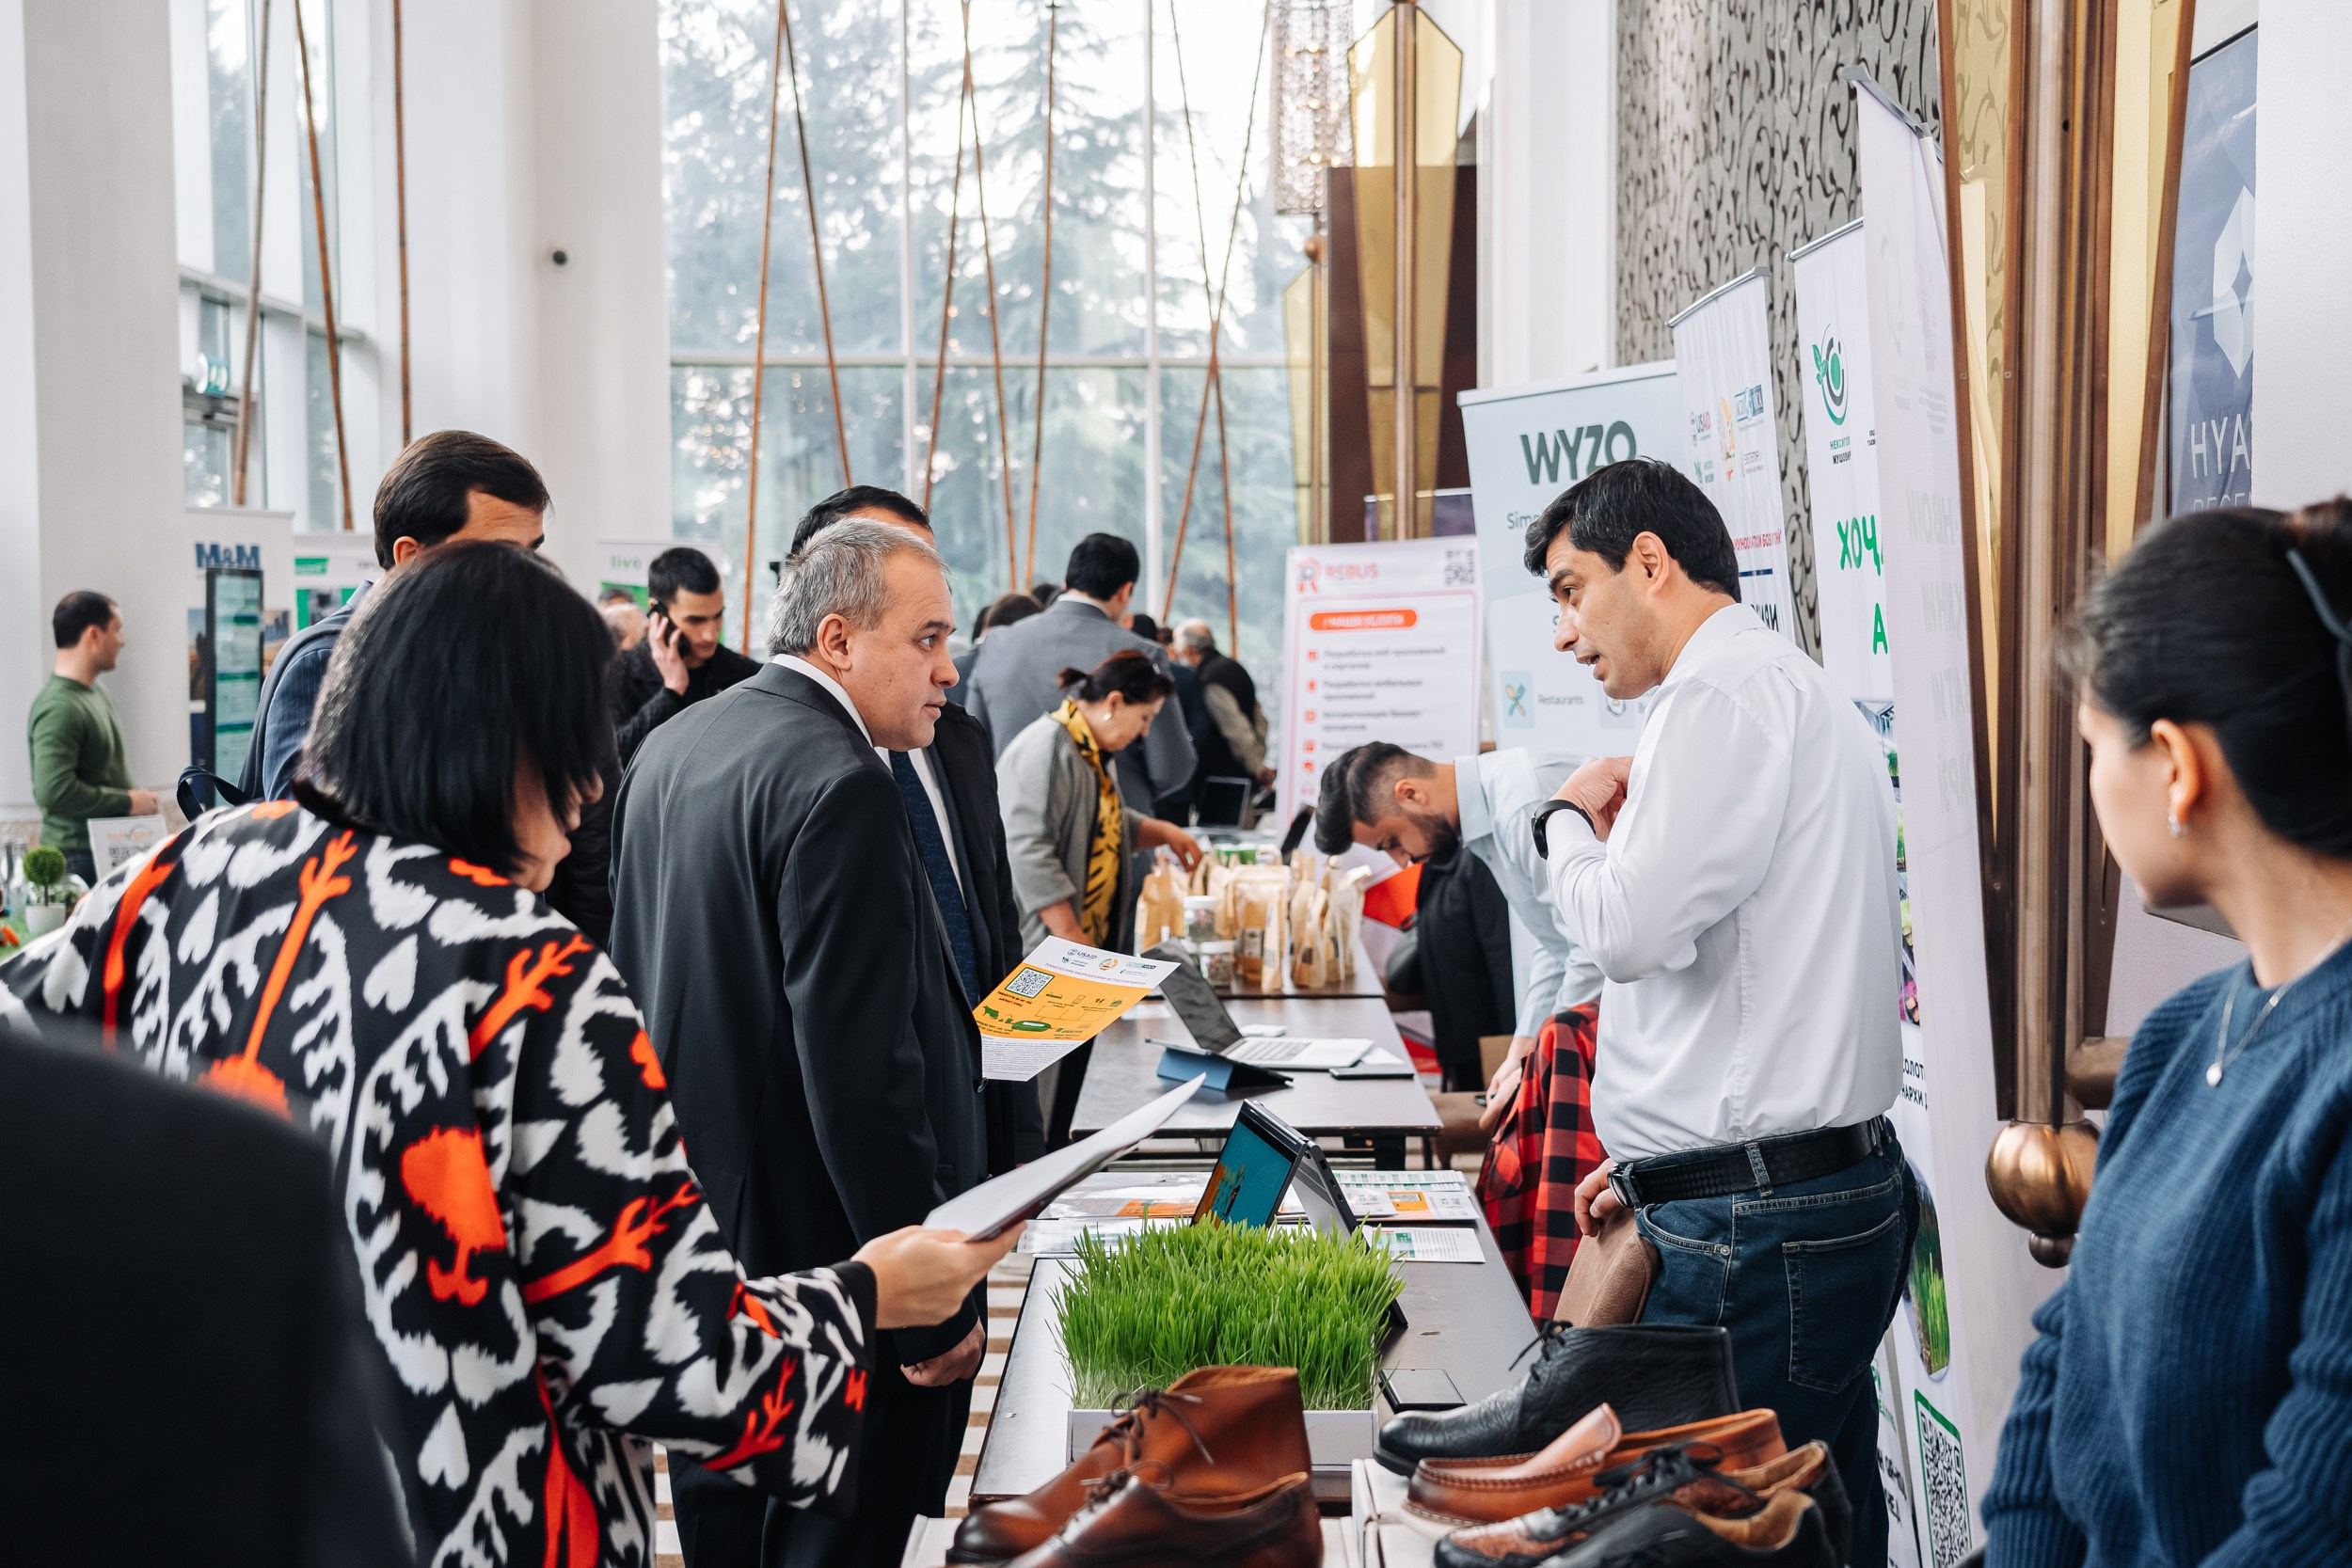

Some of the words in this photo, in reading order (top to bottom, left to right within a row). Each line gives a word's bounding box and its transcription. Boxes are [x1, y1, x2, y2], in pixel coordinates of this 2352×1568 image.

[1520, 420, 1637, 485] WYZO
[2190, 413, 2251, 479] HYA
[196, 543, 260, 568] M&M
[1537, 694, 1584, 705] Restaurants
